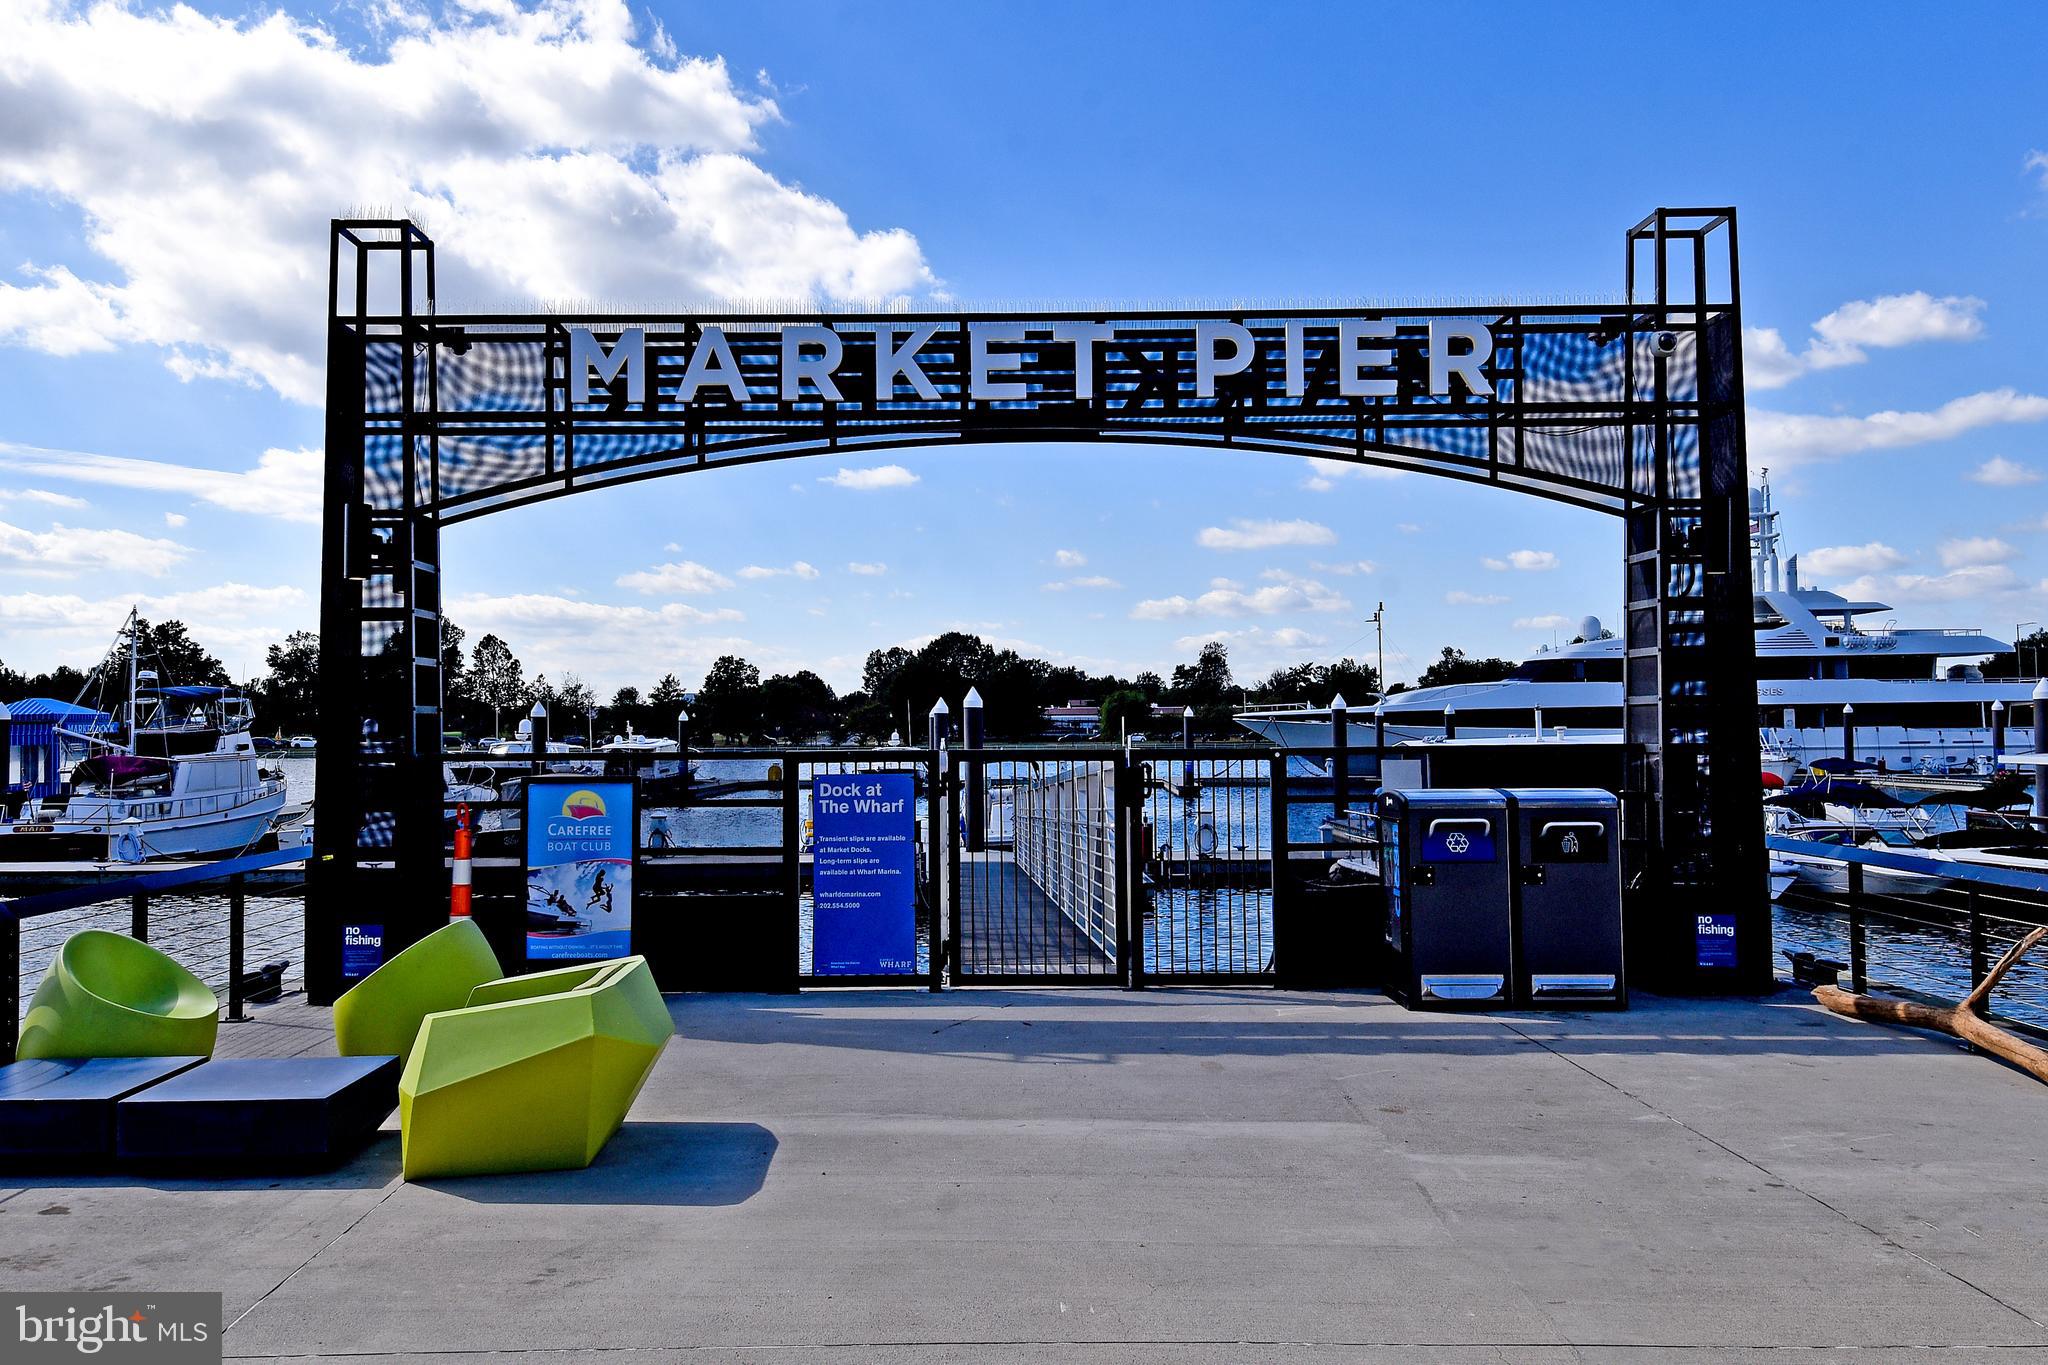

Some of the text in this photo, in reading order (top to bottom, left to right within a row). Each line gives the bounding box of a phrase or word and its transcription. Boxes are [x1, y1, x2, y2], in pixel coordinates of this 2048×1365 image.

[570, 320, 1495, 402] MARKET PIER
[820, 783, 882, 797] Dock at
[819, 798, 904, 813] The Wharf
[547, 823, 612, 836] CAREFREE
[850, 835, 864, 843] slips
[547, 842, 611, 851] BOAT CLUB
[819, 858, 851, 866] Long-term
[1697, 924, 1734, 937] fishing
[345, 935, 381, 947] fishing
[551, 951, 608, 959] carefreeboats.com
[880, 960, 912, 968] WHARF
